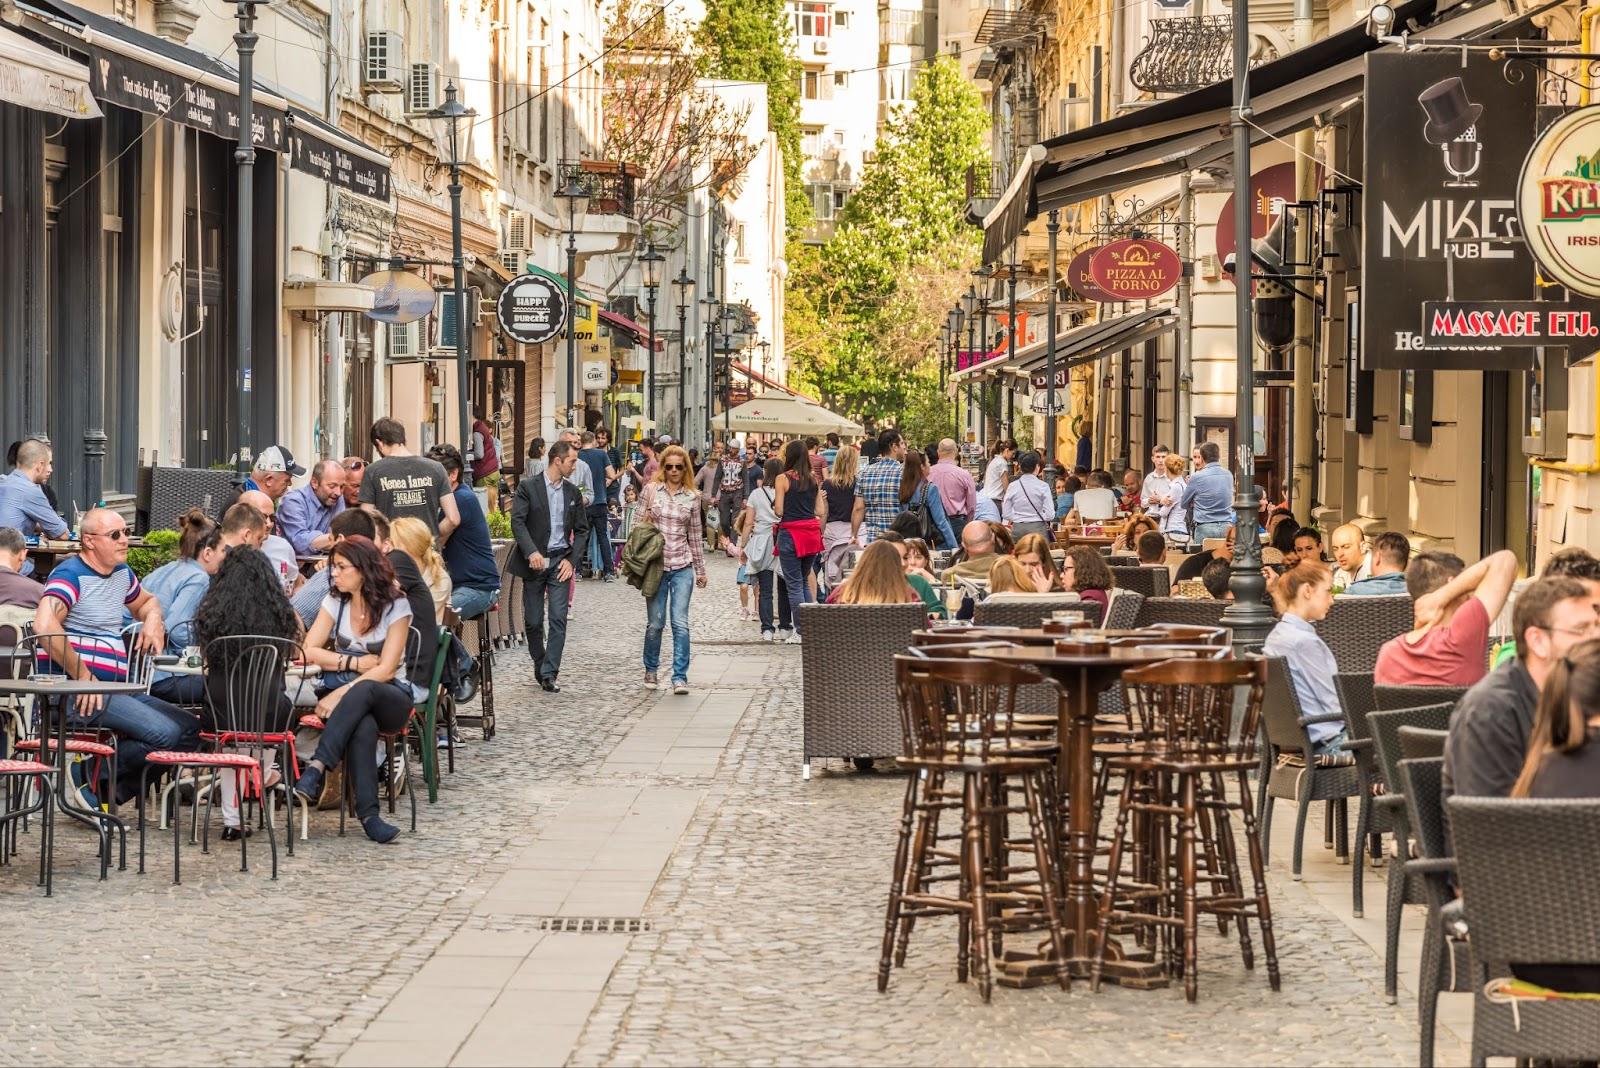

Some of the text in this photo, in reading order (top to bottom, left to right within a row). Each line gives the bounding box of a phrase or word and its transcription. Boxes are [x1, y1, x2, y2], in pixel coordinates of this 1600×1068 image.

[184, 82, 215, 110] The Address
[1550, 183, 1600, 213] KIL
[1567, 235, 1600, 246] IRIS
[1443, 242, 1479, 259] PUB
[1106, 268, 1166, 280] PIZZA AL
[1112, 279, 1160, 291] FORNO
[516, 297, 548, 306] HAPPY
[513, 314, 549, 322] BURGERS
[1430, 308, 1541, 337] MASSAGE
[380, 476, 408, 492] Nenea
